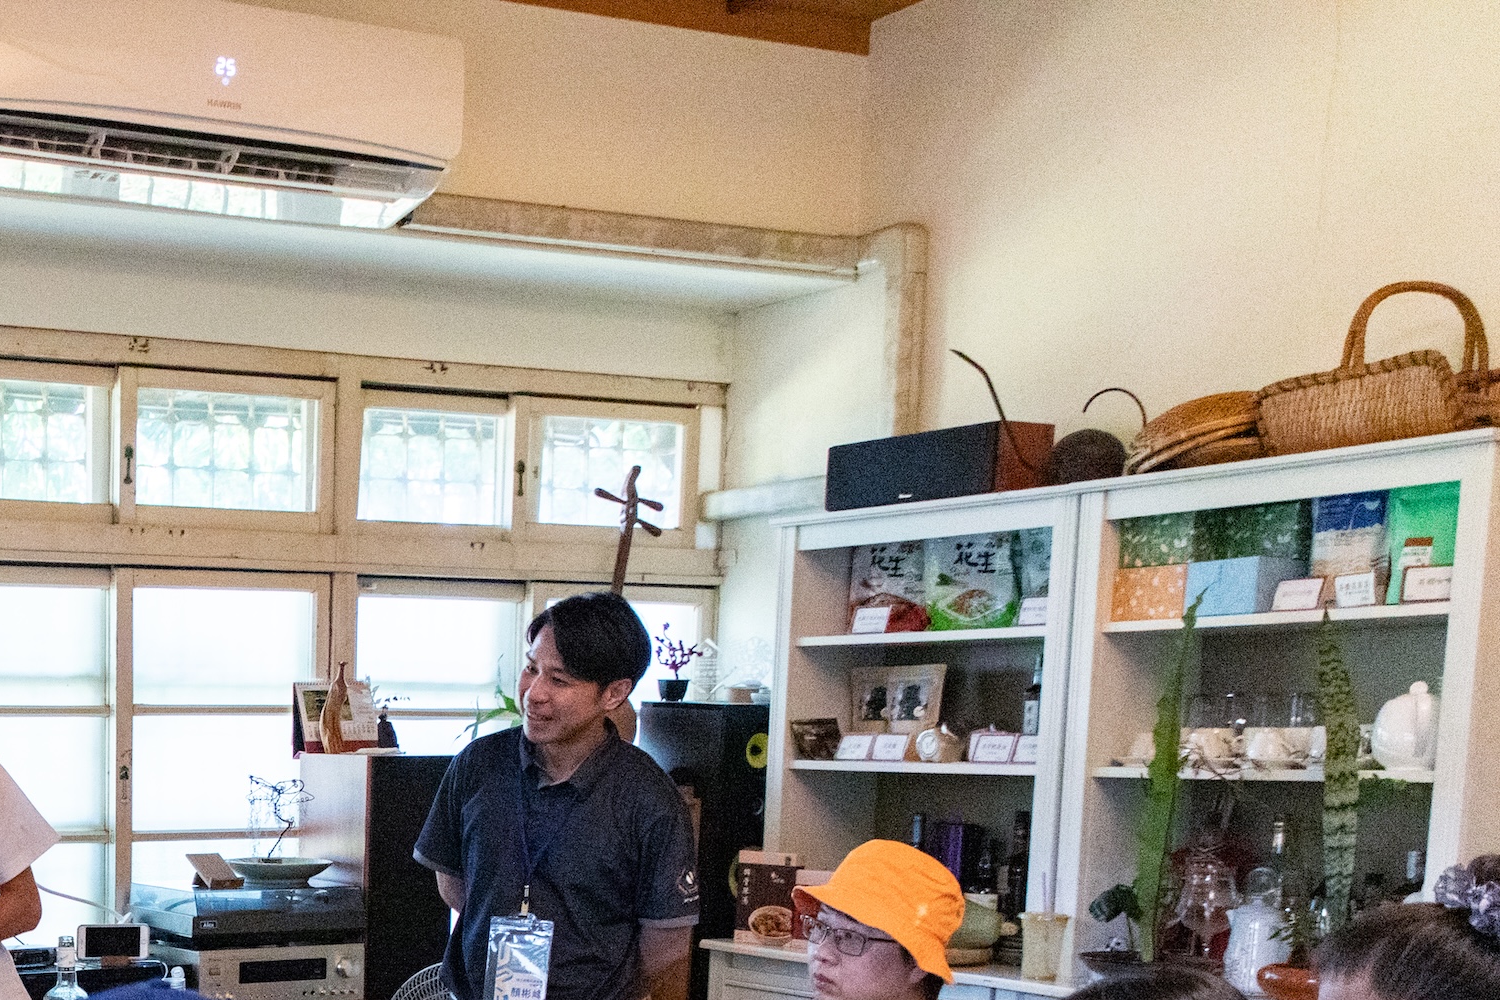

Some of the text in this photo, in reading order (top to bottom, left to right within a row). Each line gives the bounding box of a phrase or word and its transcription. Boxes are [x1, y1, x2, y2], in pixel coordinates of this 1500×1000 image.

[215, 56, 236, 77] 25
[871, 546, 906, 578] 花生
[955, 541, 997, 574] 花生
